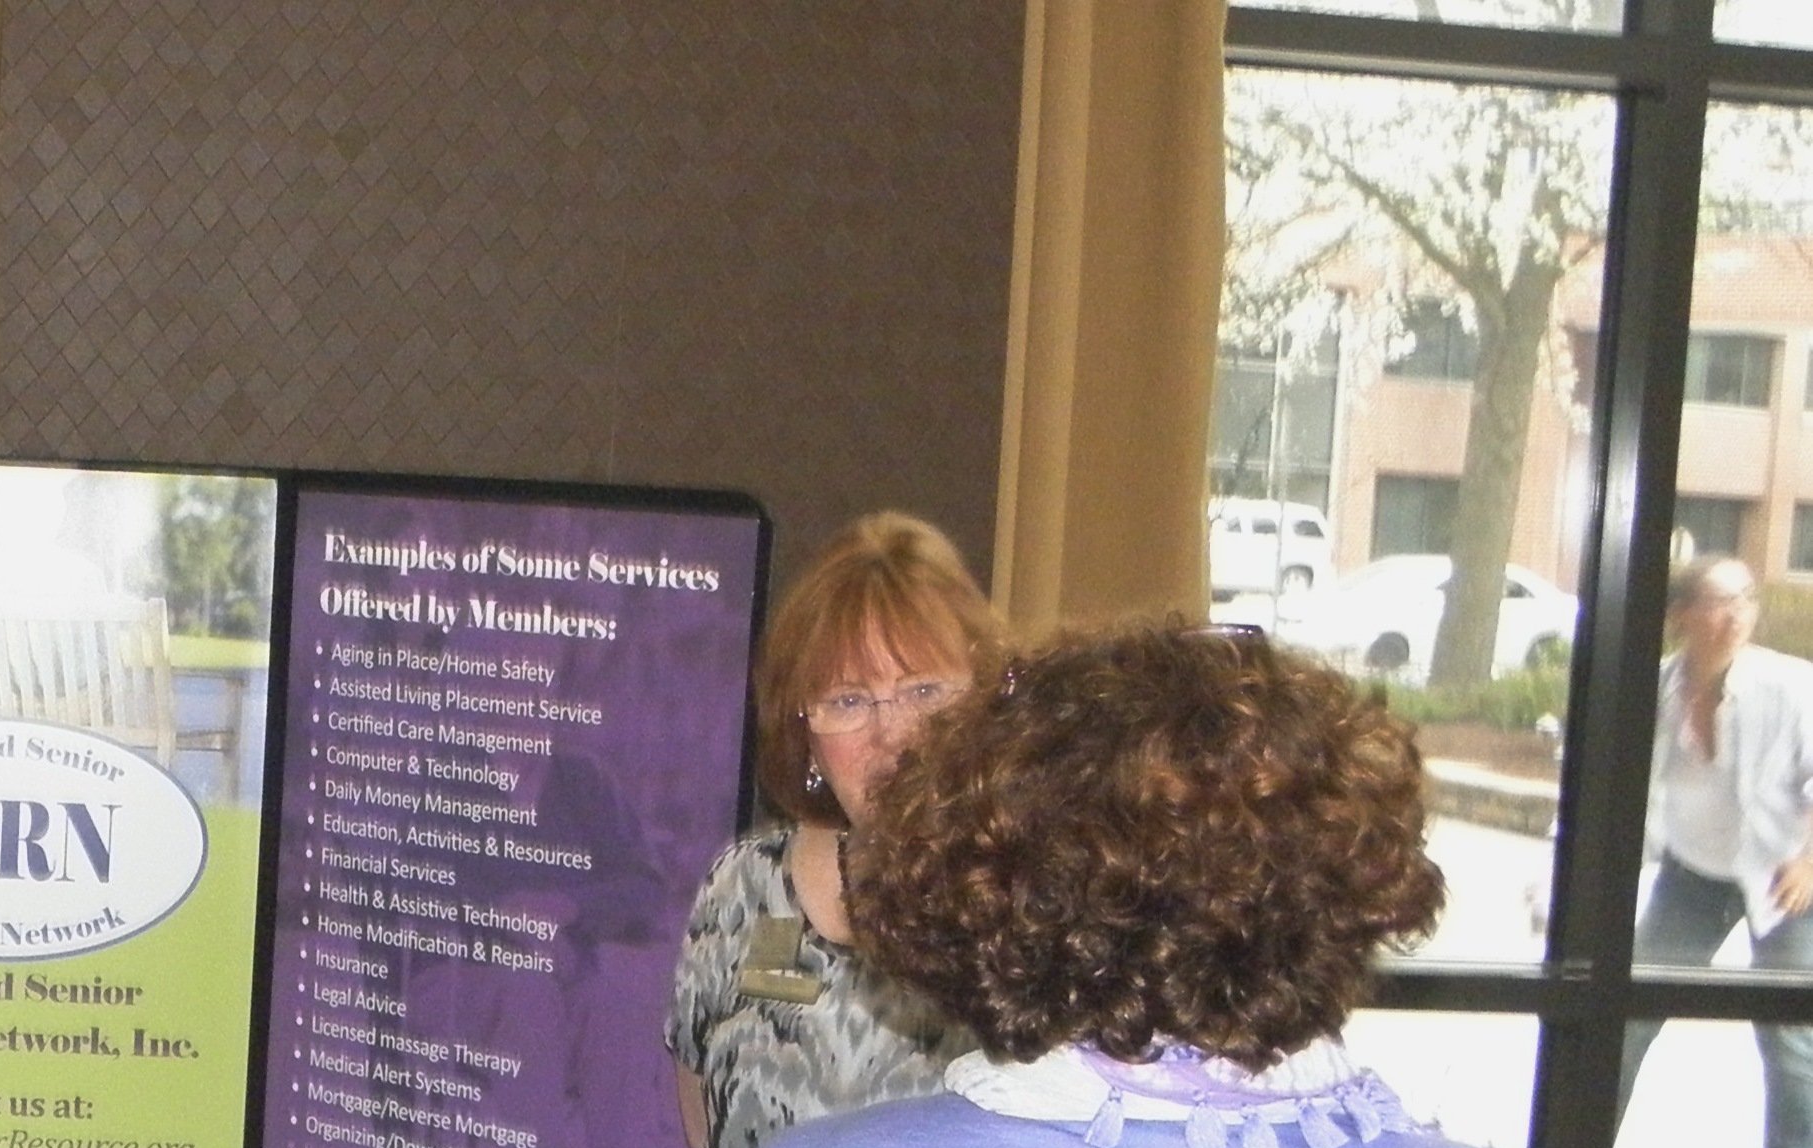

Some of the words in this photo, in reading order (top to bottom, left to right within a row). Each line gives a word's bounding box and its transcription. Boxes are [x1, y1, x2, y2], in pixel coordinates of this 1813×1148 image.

[324, 534, 456, 575] Examples
[461, 543, 495, 574] of
[496, 546, 581, 580] Some
[586, 552, 719, 590] Services
[319, 587, 420, 624] Offered
[426, 595, 460, 634] by
[467, 599, 617, 639] Members:
[331, 644, 374, 672] Aging
[378, 648, 392, 666] in
[397, 650, 497, 676] Place/Home
[502, 659, 555, 688] Safety
[329, 679, 392, 702] Assisted
[396, 686, 442, 714] Living
[446, 691, 534, 716] Placement
[539, 700, 602, 723] Service
[328, 713, 394, 737] Certified
[397, 721, 434, 741] Care
[439, 725, 552, 754] Management
[25, 738, 127, 784] Senior
[327, 746, 404, 771] Computer
[427, 757, 519, 790] Technology
[325, 780, 362, 809] Daily
[365, 786, 421, 816] Money
[425, 793, 537, 823] Management
[323, 814, 402, 844] Education,
[407, 826, 481, 853] Activities
[504, 839, 592, 867] Resources
[322, 848, 386, 873] Financial
[391, 858, 456, 884] Services
[0, 905, 127, 948] Network
[319, 882, 368, 905] Health
[389, 892, 458, 919] Assistive
[464, 904, 558, 942] Technology
[316, 949, 388, 977] Insurance
[317, 916, 363, 939] Home
[367, 924, 468, 957] Modification
[491, 944, 554, 971] Repairs
[25, 974, 144, 1006] Senior
[313, 983, 352, 1008] Legal
[355, 991, 407, 1015] Advice
[132, 1028, 201, 1059] Inc.
[312, 1016, 376, 1043] Licensed
[381, 1032, 450, 1060] massage
[455, 1042, 522, 1075] Therapy
[310, 1049, 369, 1076] Medical
[373, 1062, 412, 1084] Alert
[415, 1070, 482, 1098] Systems
[10, 1096, 45, 1119] us
[53, 1094, 94, 1120] at:
[308, 1082, 451, 1127] Mortgage/Reverse
[456, 1113, 537, 1148] Mortgage
